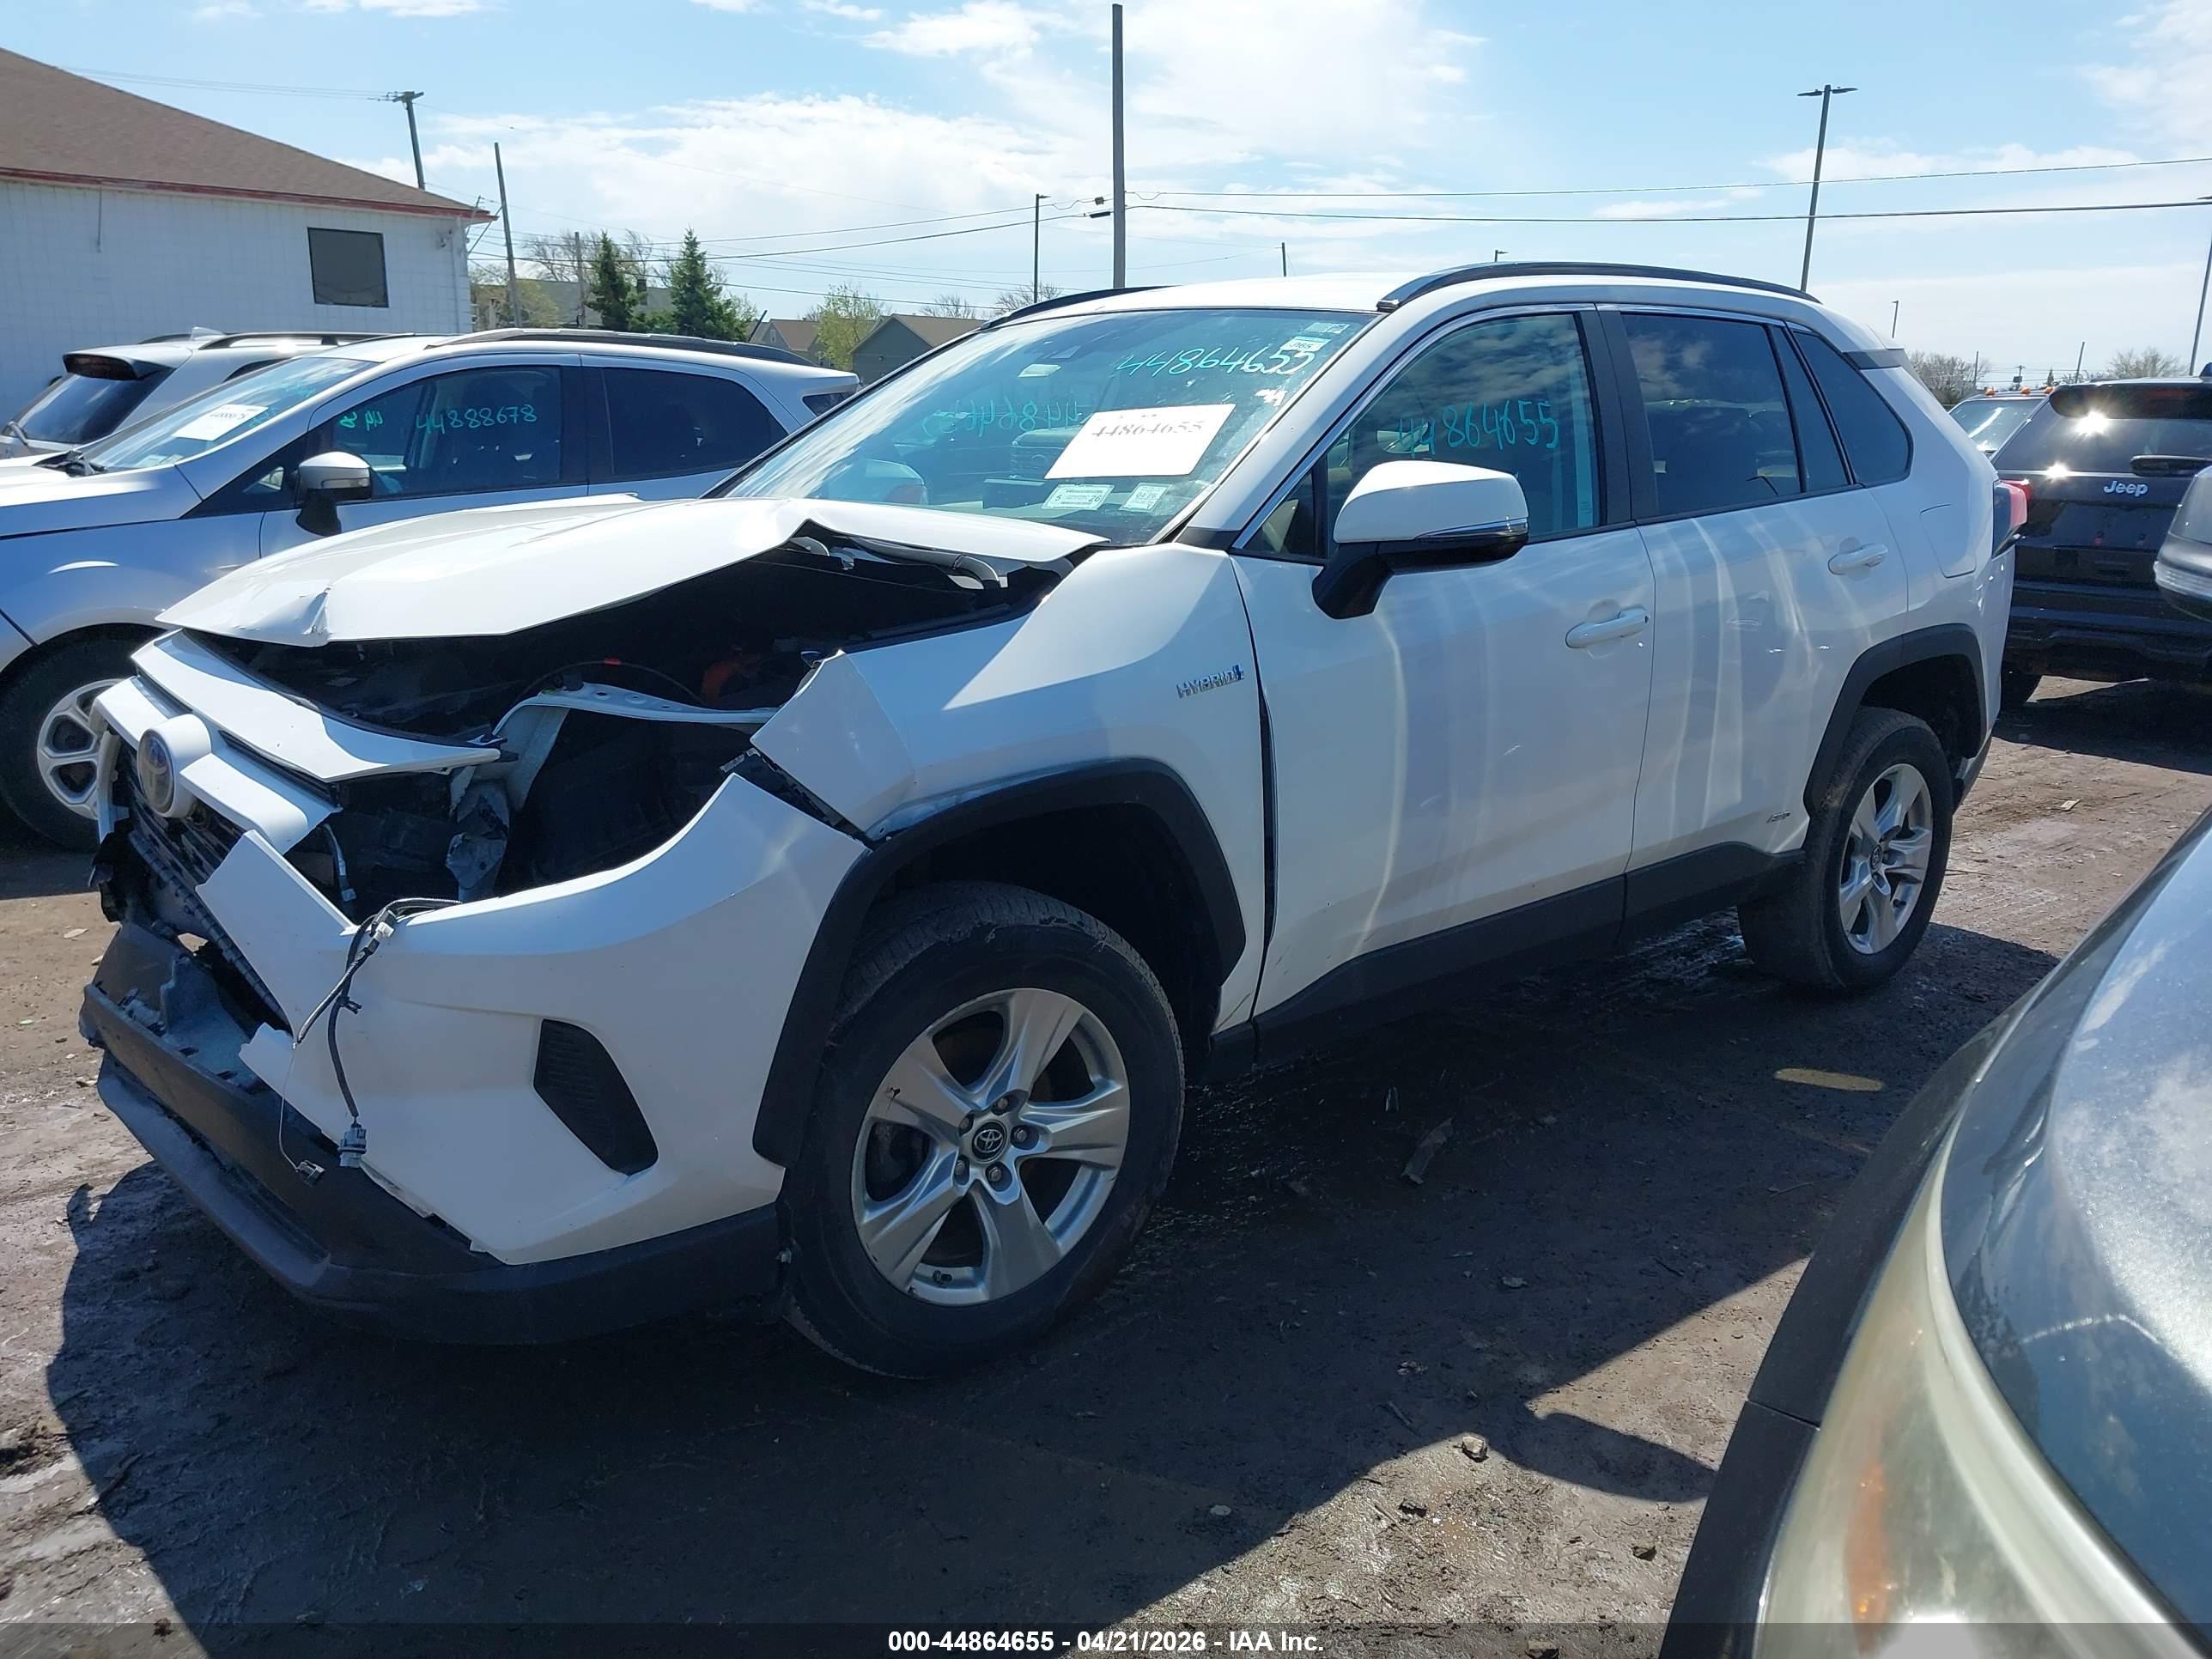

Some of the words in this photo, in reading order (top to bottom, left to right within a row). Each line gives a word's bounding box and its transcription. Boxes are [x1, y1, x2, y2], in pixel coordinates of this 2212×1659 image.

[1117, 346, 1316, 377] 44864655
[416, 404, 538, 434] 44888678
[1398, 399, 1559, 459] 44864655
[2103, 480, 2148, 497] Jeep
